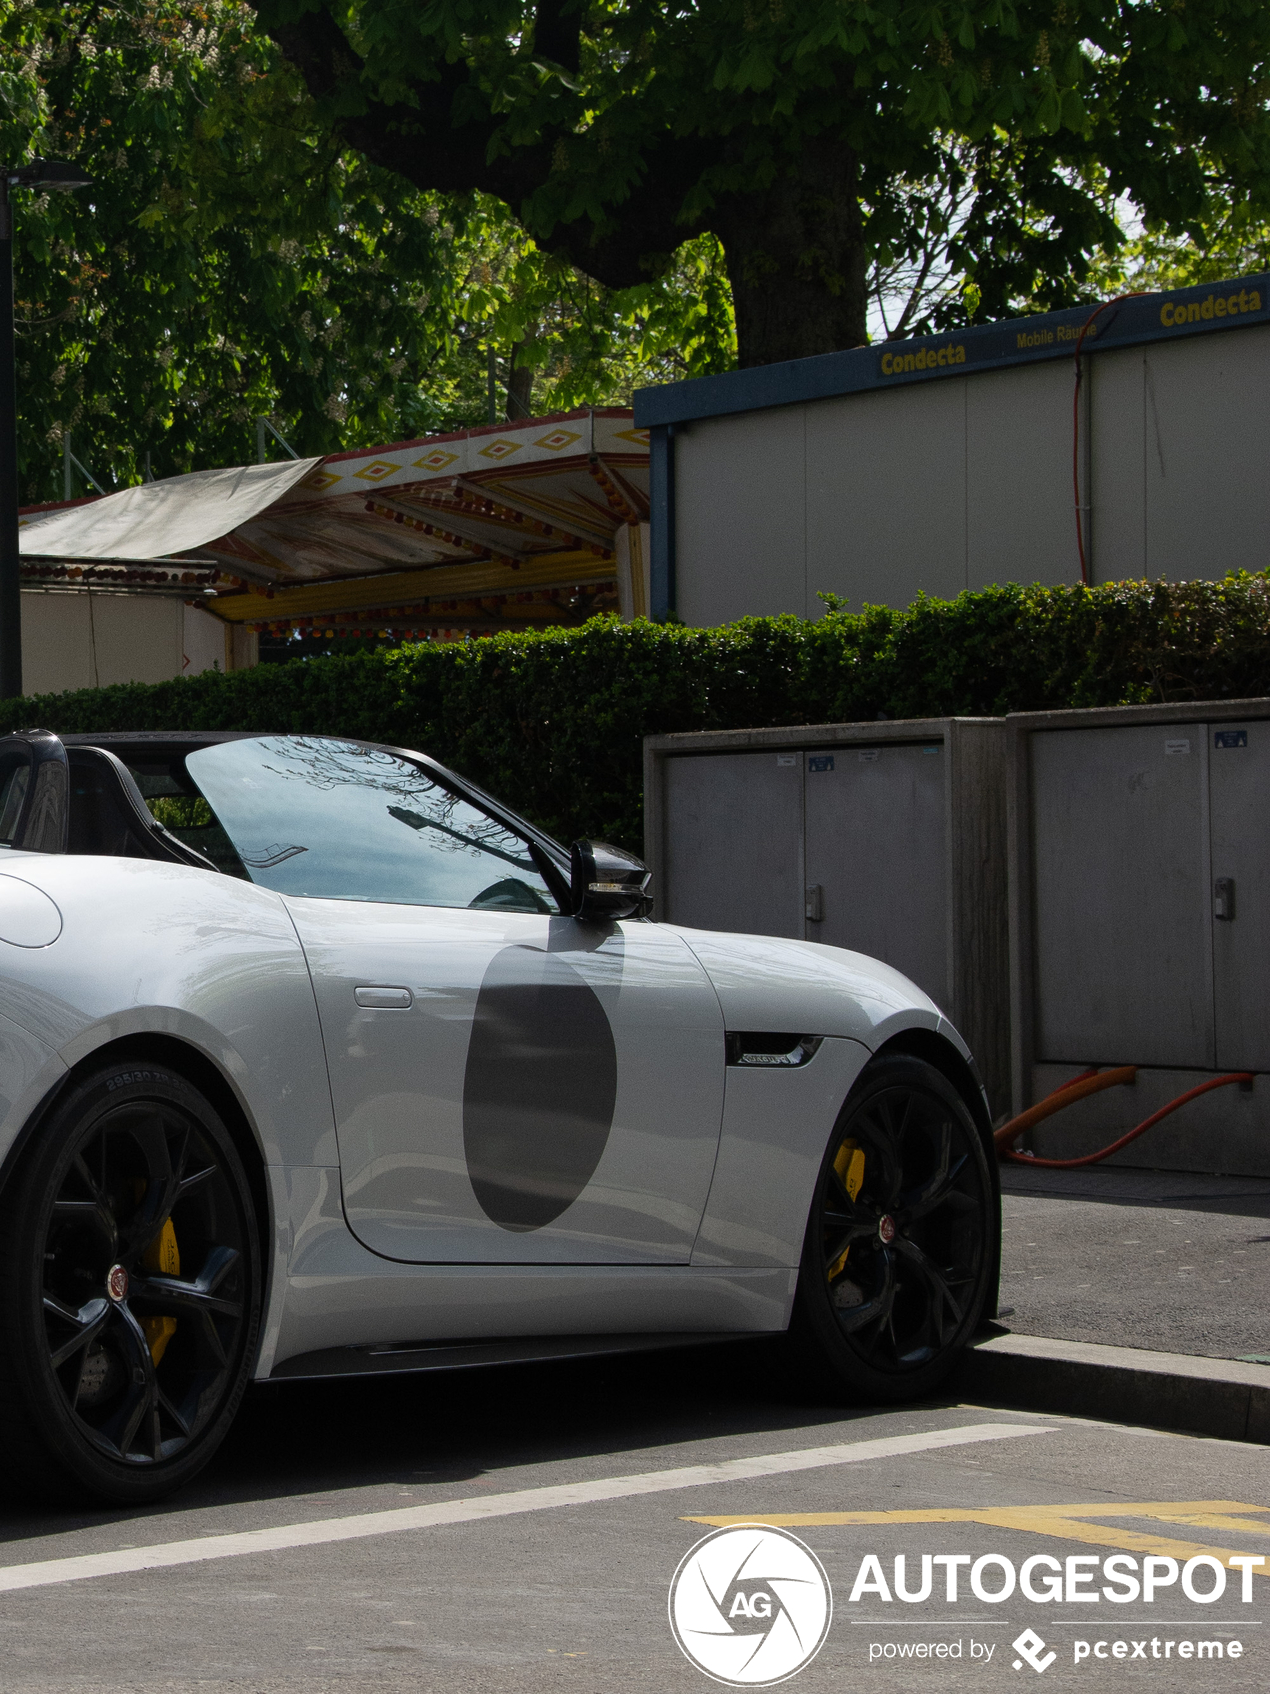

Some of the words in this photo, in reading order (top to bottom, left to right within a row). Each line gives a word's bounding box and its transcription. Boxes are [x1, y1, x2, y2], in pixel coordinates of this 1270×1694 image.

[1160, 288, 1262, 327] Condecta
[881, 343, 966, 375] Condecta
[1016, 329, 1054, 349] Mobile
[106, 1070, 151, 1092] 295/30
